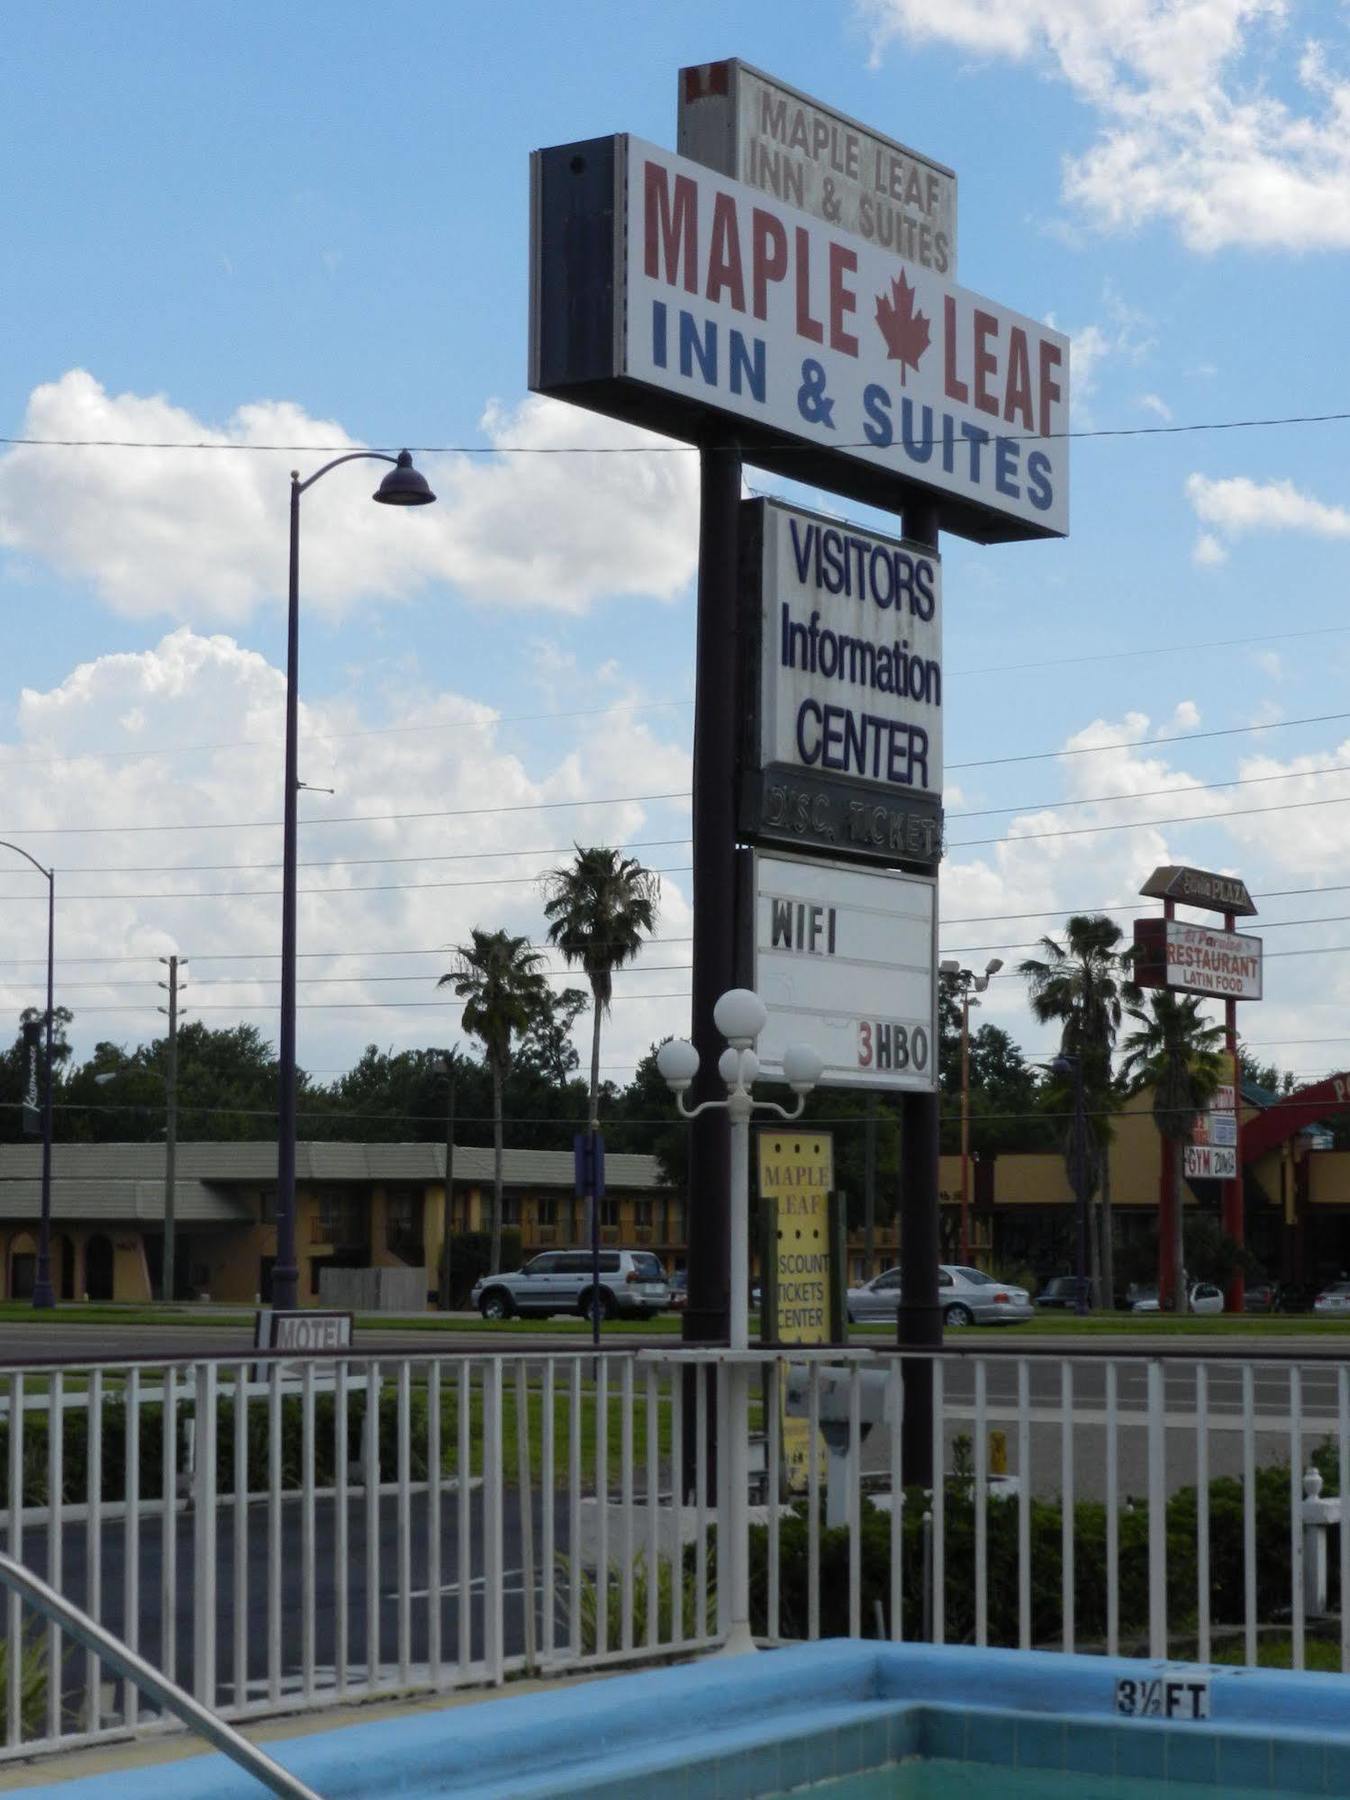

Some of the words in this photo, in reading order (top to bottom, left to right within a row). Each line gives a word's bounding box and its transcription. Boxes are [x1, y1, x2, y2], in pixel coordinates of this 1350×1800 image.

[762, 91, 859, 180] MAPLE
[875, 149, 939, 216] LEAF
[750, 137, 803, 208] INN
[822, 176, 842, 222] &
[859, 191, 949, 273] SUITES
[644, 160, 859, 358] MAPLE
[943, 294, 1062, 437] LEAF
[652, 300, 766, 403] INN
[798, 358, 836, 430] &
[862, 383, 1054, 511] SUITES
[789, 518, 936, 622] VISITORS
[781, 602, 941, 706] Information
[796, 698, 929, 788] CENTER
[771, 899, 836, 954] WIFI
[1167, 942, 1258, 978] RESTAURANT
[1183, 969, 1213, 988] LATIN
[1216, 976, 1243, 992] FOOD
[764, 1166, 829, 1187] MAPLE
[277, 1319, 349, 1350] MOTEL
[777, 1308, 824, 1329] CENTER
